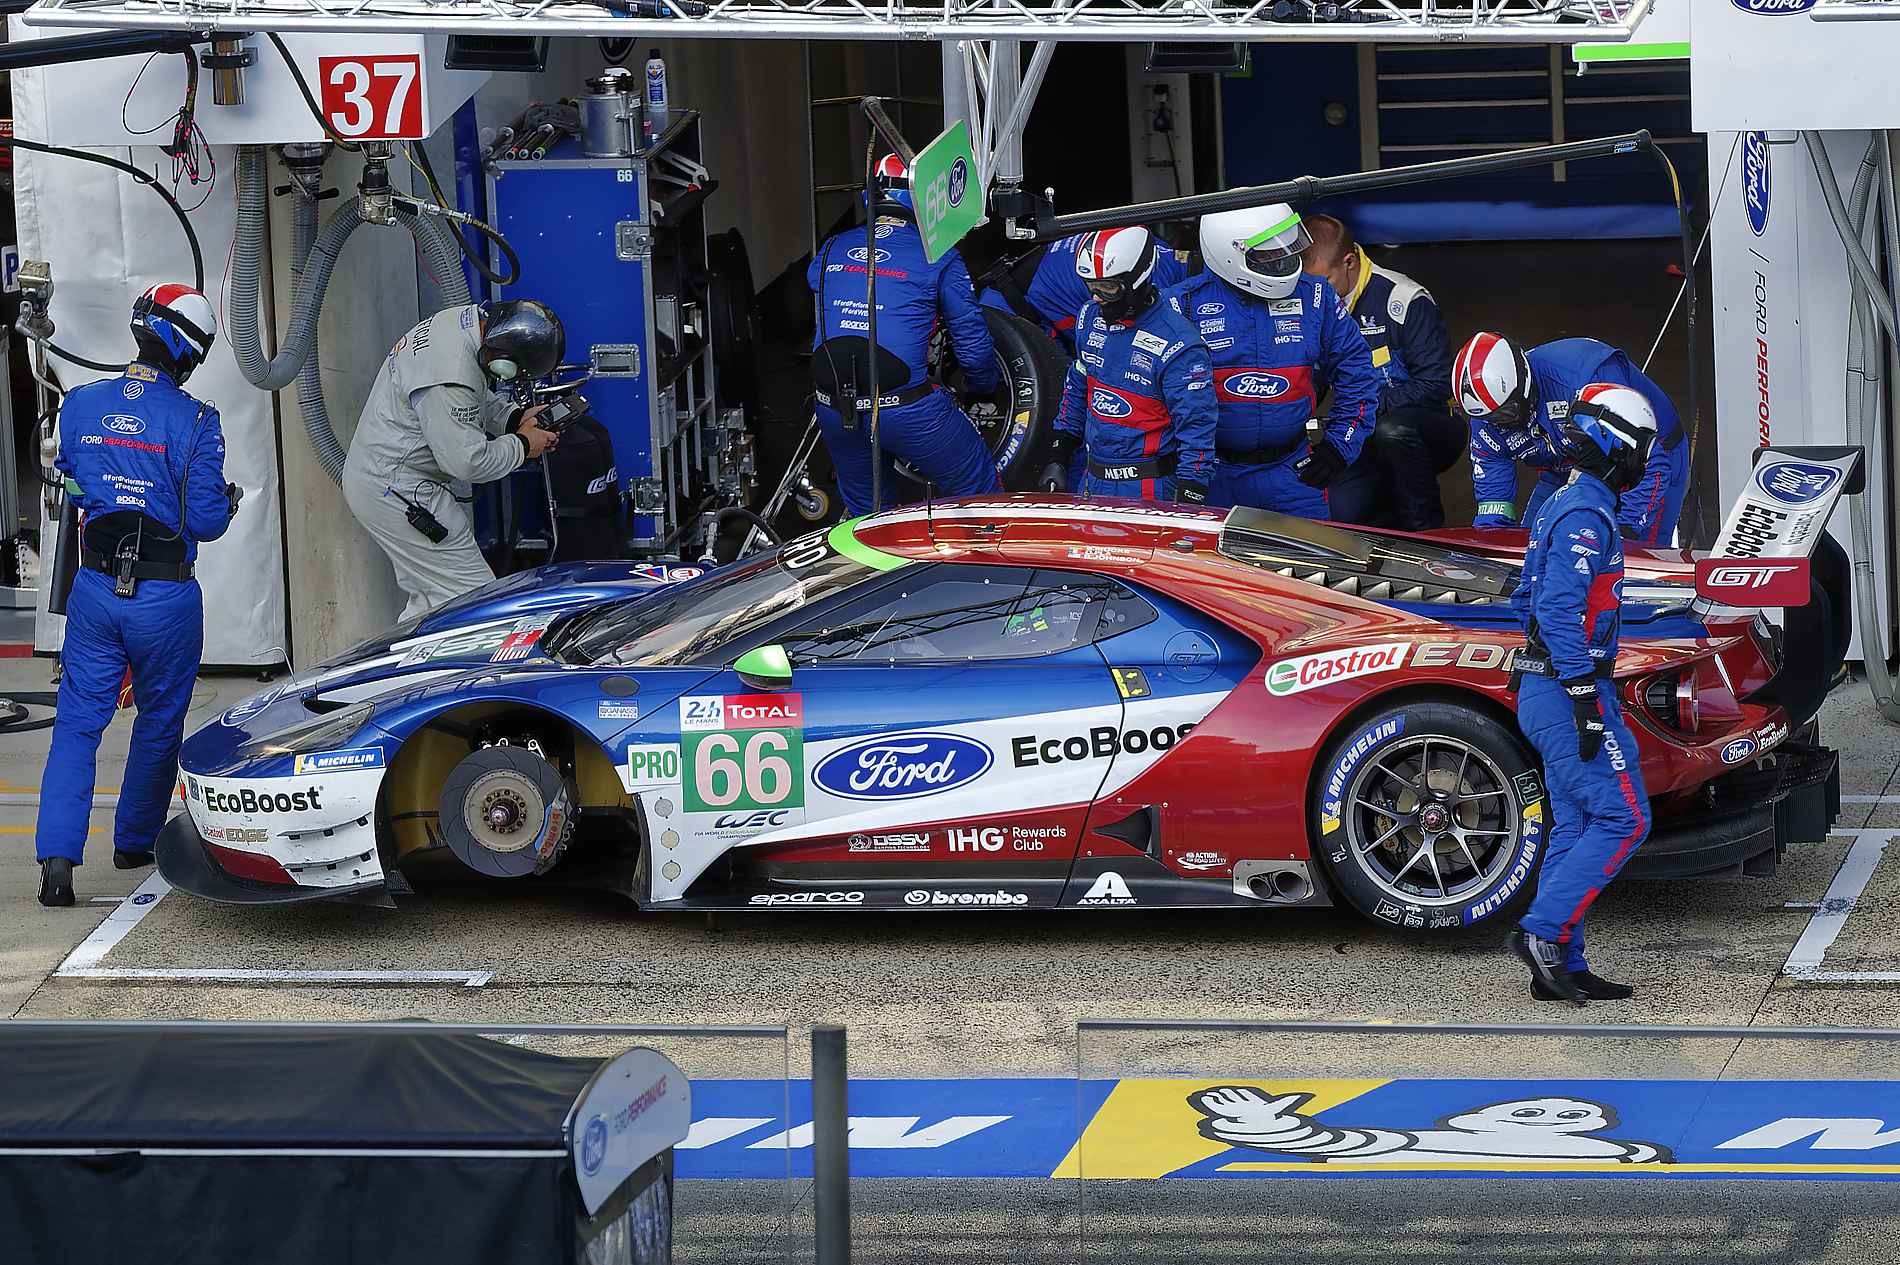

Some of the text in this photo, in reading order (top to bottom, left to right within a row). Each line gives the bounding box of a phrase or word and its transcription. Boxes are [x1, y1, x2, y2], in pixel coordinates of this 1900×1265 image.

[328, 61, 416, 137] 37
[616, 169, 633, 182] 66
[926, 170, 947, 231] 66
[825, 264, 843, 273] FORD
[1753, 270, 1767, 335] FORD
[1274, 335, 1291, 345] IHG
[1124, 371, 1140, 381] IHG
[1236, 375, 1279, 395] Ford
[856, 396, 900, 410] sprco
[1091, 391, 1121, 415] Ford
[111, 416, 138, 432] Ford
[81, 435, 102, 445] FORD
[1769, 466, 1831, 497] Ford
[968, 502, 1219, 521] PERFORMANCE
[1722, 503, 1788, 559] EcoBoos
[1706, 566, 1799, 588] GT
[1300, 642, 1515, 685] Castrol ED
[728, 704, 798, 720] TOTAL
[1760, 722, 1787, 751] EcoBoost
[317, 754, 375, 767] MICHELIN
[1328, 720, 1397, 798] MICHELIN
[1602, 731, 1627, 771] FORD
[1728, 743, 1749, 761] Ford
[632, 751, 678, 779] PRO
[695, 731, 792, 806] 66
[849, 743, 957, 791] Ford
[204, 786, 323, 813] EcoBoost
[715, 809, 788, 828] WEC
[225, 828, 269, 842] EDGE
[540, 811, 561, 854] brembo
[1012, 826, 1067, 838] Rewards
[1013, 838, 1044, 851] Club
[1471, 840, 1537, 919] MICHELIN
[749, 891, 865, 906] sparco
[931, 890, 1029, 905] brembo
